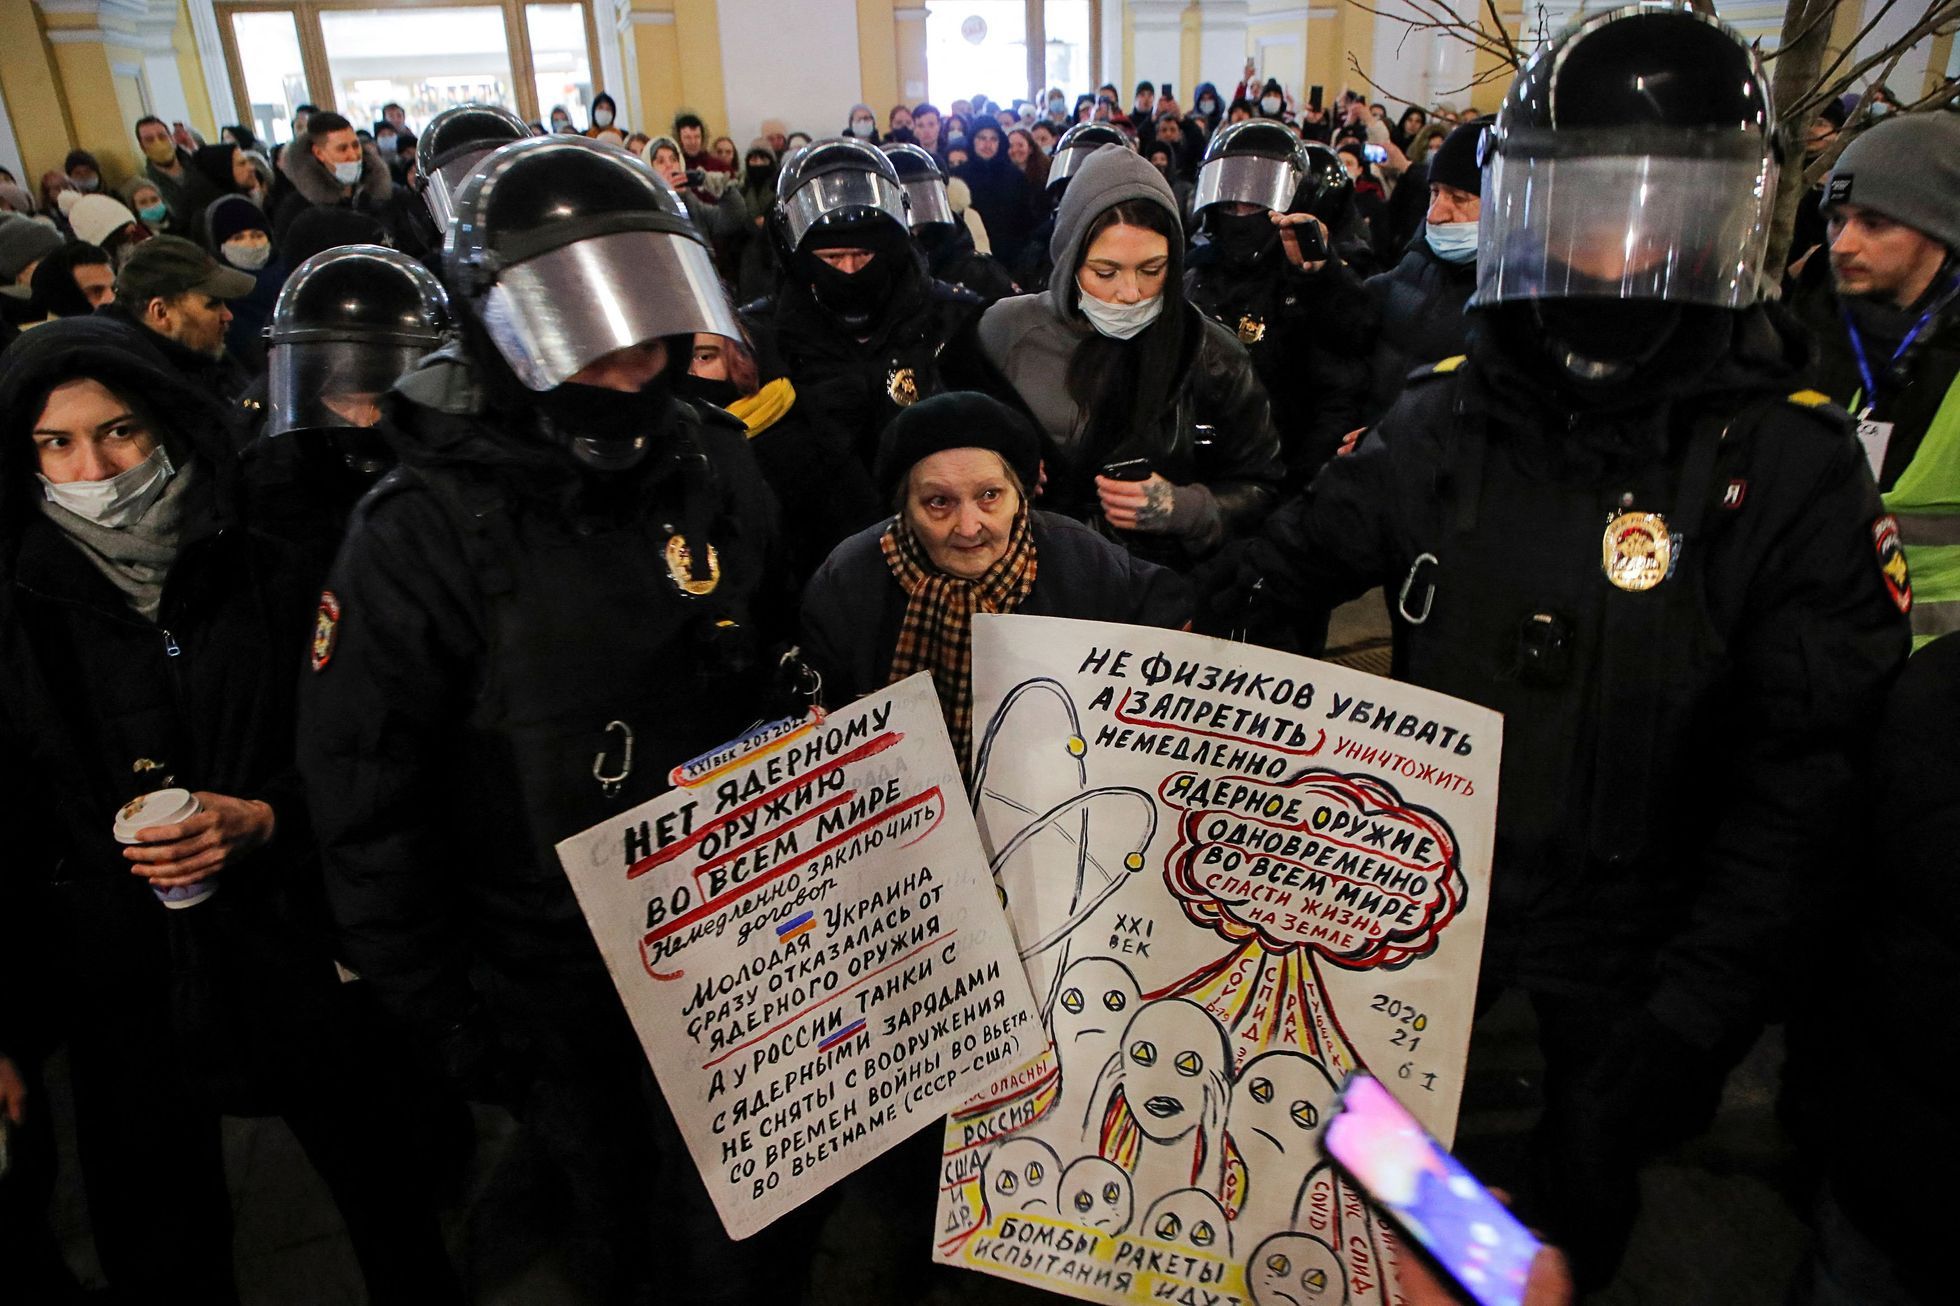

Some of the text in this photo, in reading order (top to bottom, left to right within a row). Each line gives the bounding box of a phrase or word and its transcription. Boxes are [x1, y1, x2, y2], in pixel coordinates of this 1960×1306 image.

[1078, 647, 1473, 757] НЕ ФИЗИКОВ УБИВАТЬ
[1088, 686, 1476, 797] А ЗАПРЕТИТЬ УНИЧТОЖИТЬ
[1095, 724, 1289, 779] НЕМЕДЛЕННО
[624, 700, 892, 865] НЕТ ЯДЕРНОМУ
[698, 767, 845, 860] ОРУЖИЮ
[1166, 774, 1437, 865] ЯДЕРНОЕ ОРУЖИЕ
[646, 778, 901, 929] ВО ВСЕМ МИРЕ
[650, 805, 935, 967] Немедленно ЗАКЛЮЧИТЬ
[1201, 846, 1421, 927] ВО ВСЕМ МИРЕ
[1206, 819, 1429, 898] ОДНОВРЕМЕННО
[682, 866, 933, 1016] МОЛОДАЯ УКРАИНА
[736, 878, 838, 947] договор
[1113, 913, 1154, 938] XXI
[1206, 873, 1382, 937] СПАСТИ ЖИЗНЬ
[1249, 905, 1355, 949] НА ЗЕМЛЕ
[687, 885, 944, 1044] СРАЗУ ОТКАЗАЛАСЬ ОТ
[710, 914, 940, 1053] ЯДЕРНОГО ОРУЖИЯ
[1109, 934, 1151, 959] ВЕК
[753, 1007, 843, 1074] РОССИИ
[855, 957, 933, 1013] ТАНКИ
[942, 944, 957, 964] С
[882, 960, 1001, 1037] ЗАРЯДАМИ
[1241, 967, 1278, 1043] СПИД
[1283, 994, 1297, 1044] РАК
[1369, 994, 1428, 1032] 2020
[721, 989, 1006, 1165] НЕ СНЯТЫ С ВООРУЖЕНИЯ
[990, 1059, 1047, 1096] ОПАСНЫ
[1389, 1028, 1421, 1052] 21
[730, 1158, 756, 1184] СО
[766, 1104, 858, 1168] ВРЕМЕН
[868, 1053, 941, 1107] ВОЙНЫ
[951, 1034, 977, 1060] ВО
[963, 1099, 1036, 1147] РОССИЯ
[752, 1171, 780, 1200] ВО
[791, 1102, 898, 1177] ВЬЕТНАМЕ
[945, 1148, 982, 1183] США
[1309, 1181, 1330, 1230] COVID
[974, 1237, 1133, 1294] ИСПЫТАНИЯ
[999, 1217, 1225, 1284] БОМБЫ РАКЕТЫ
[1350, 1235, 1374, 1295] СПИД
